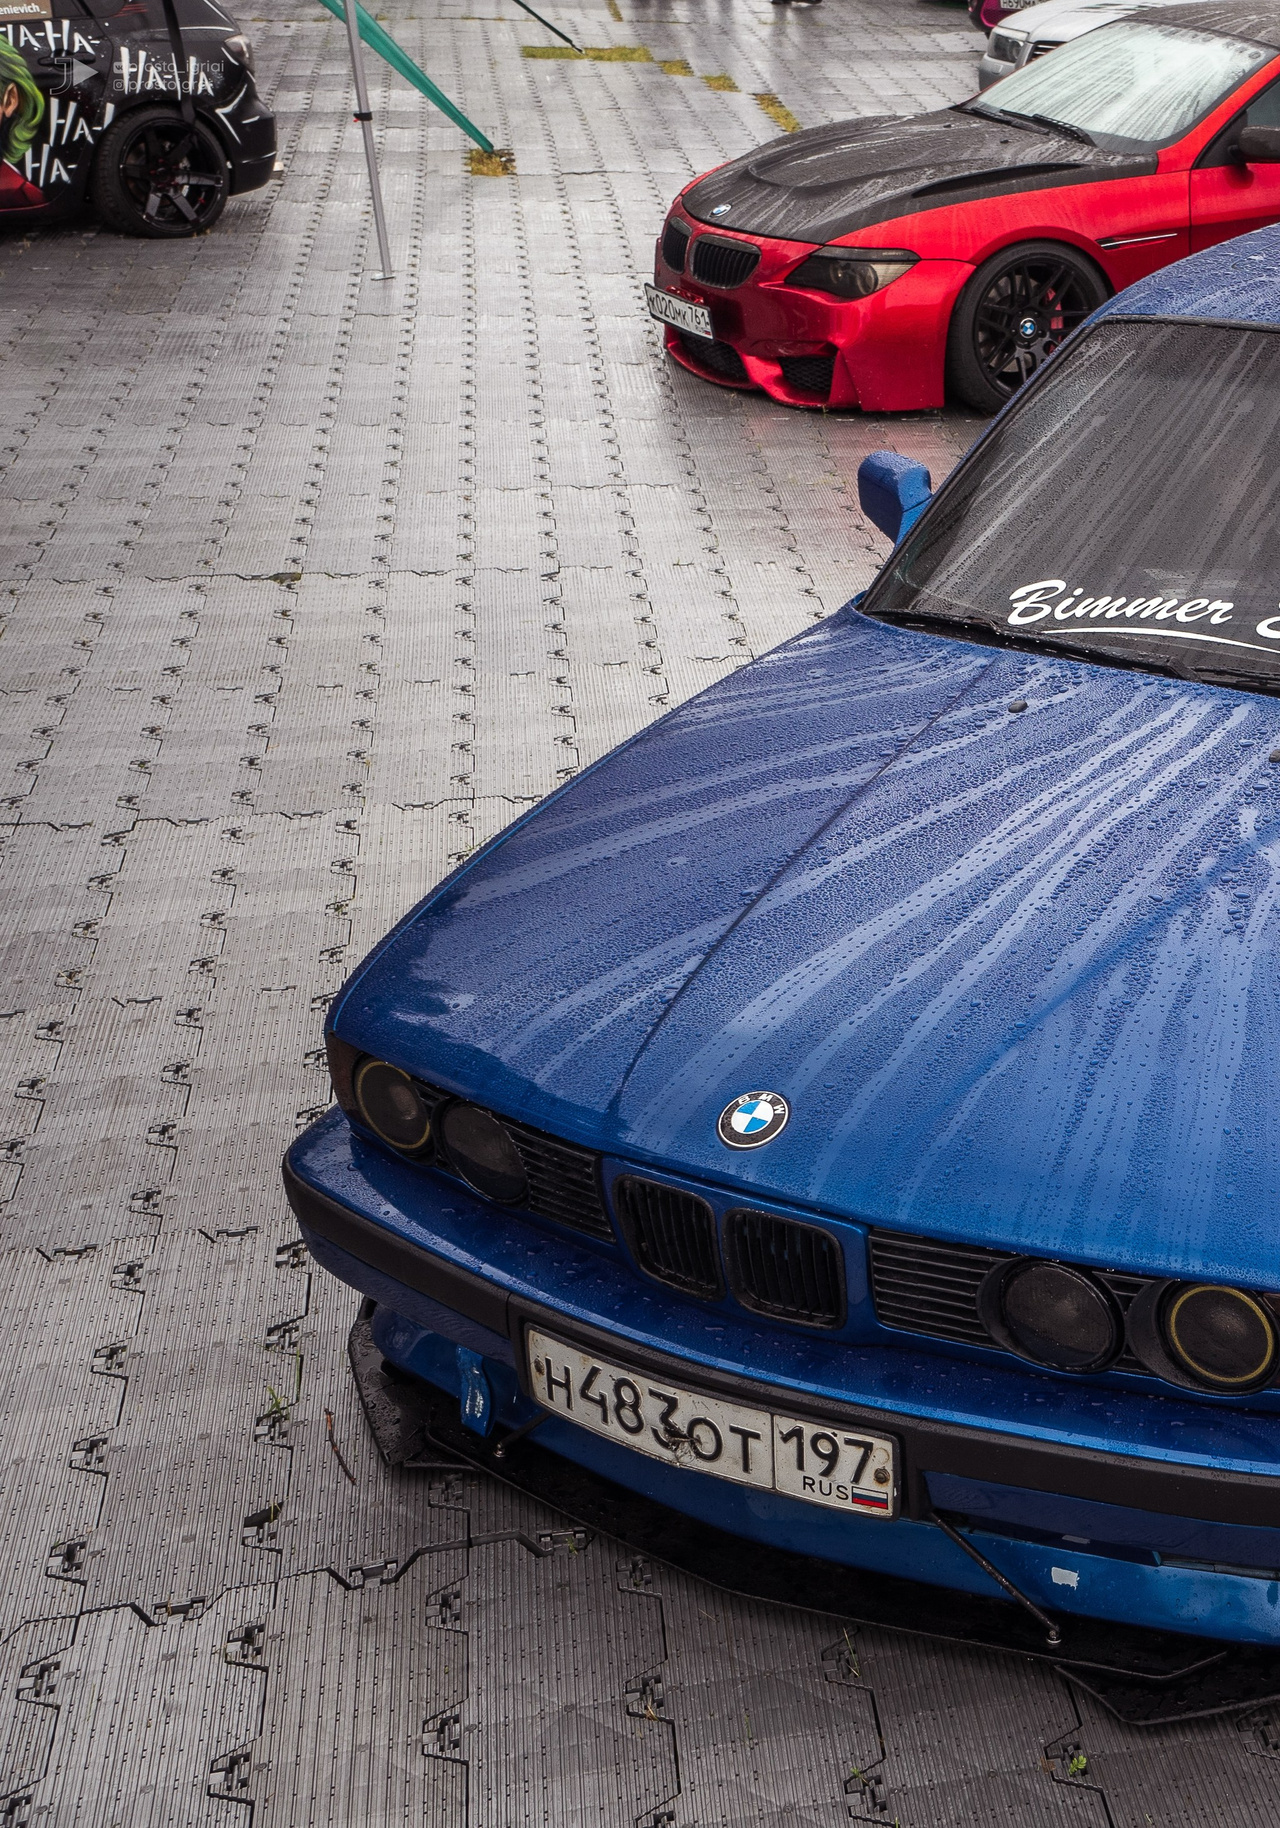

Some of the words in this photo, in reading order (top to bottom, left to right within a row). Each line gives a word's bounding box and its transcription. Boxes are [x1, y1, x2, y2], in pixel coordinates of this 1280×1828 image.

[1008, 579, 1233, 626] Bimmer
[738, 1093, 786, 1115] BMW
[778, 1423, 876, 1485] 197
[801, 1474, 851, 1501] RUS
